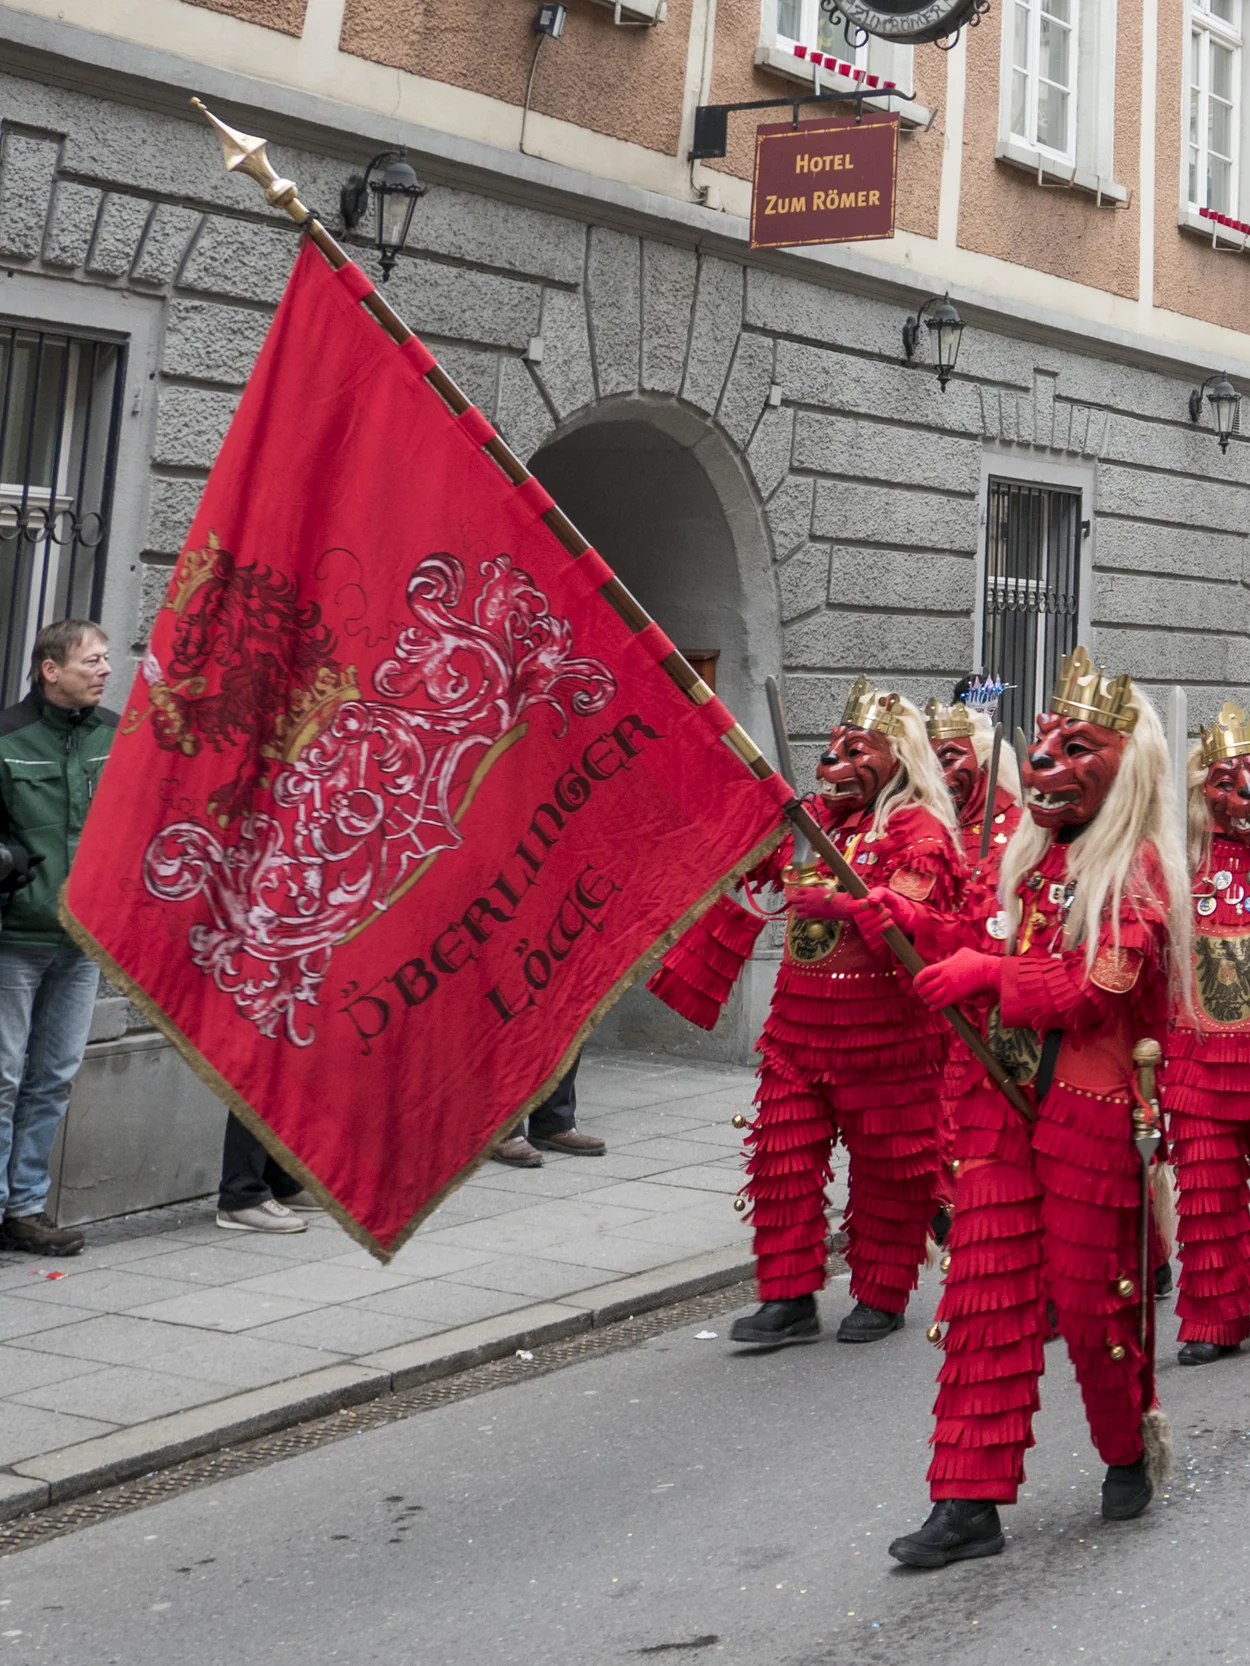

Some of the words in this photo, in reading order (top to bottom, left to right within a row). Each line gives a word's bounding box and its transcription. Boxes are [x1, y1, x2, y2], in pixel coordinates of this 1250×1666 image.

[795, 154, 853, 174] HOTEL
[764, 195, 806, 215] ZUM
[812, 189, 880, 211] RÖMER
[338, 714, 667, 1056] ÜBERLINGER
